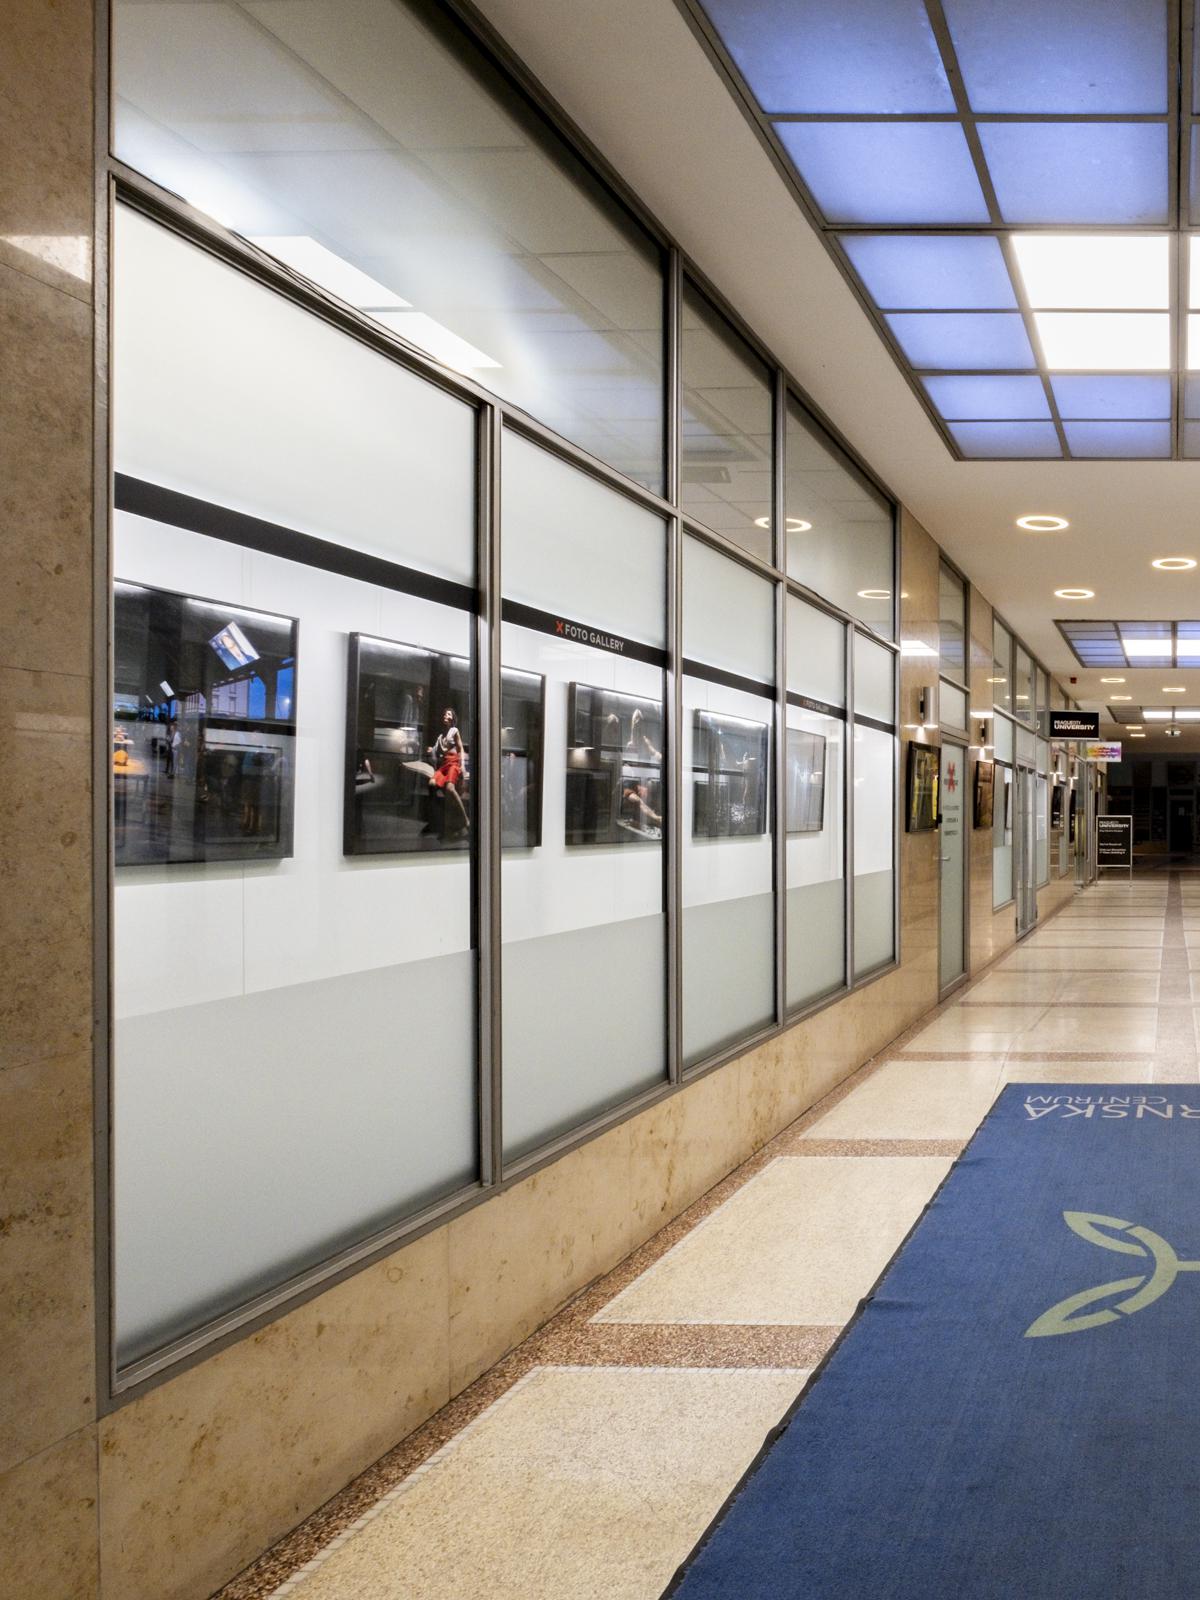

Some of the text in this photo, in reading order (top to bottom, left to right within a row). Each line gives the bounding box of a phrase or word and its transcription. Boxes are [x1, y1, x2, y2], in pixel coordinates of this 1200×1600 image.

[565, 623, 588, 641] FOTO
[590, 632, 625, 652] GALLERY
[1026, 1095, 1168, 1104] CENTRUM
